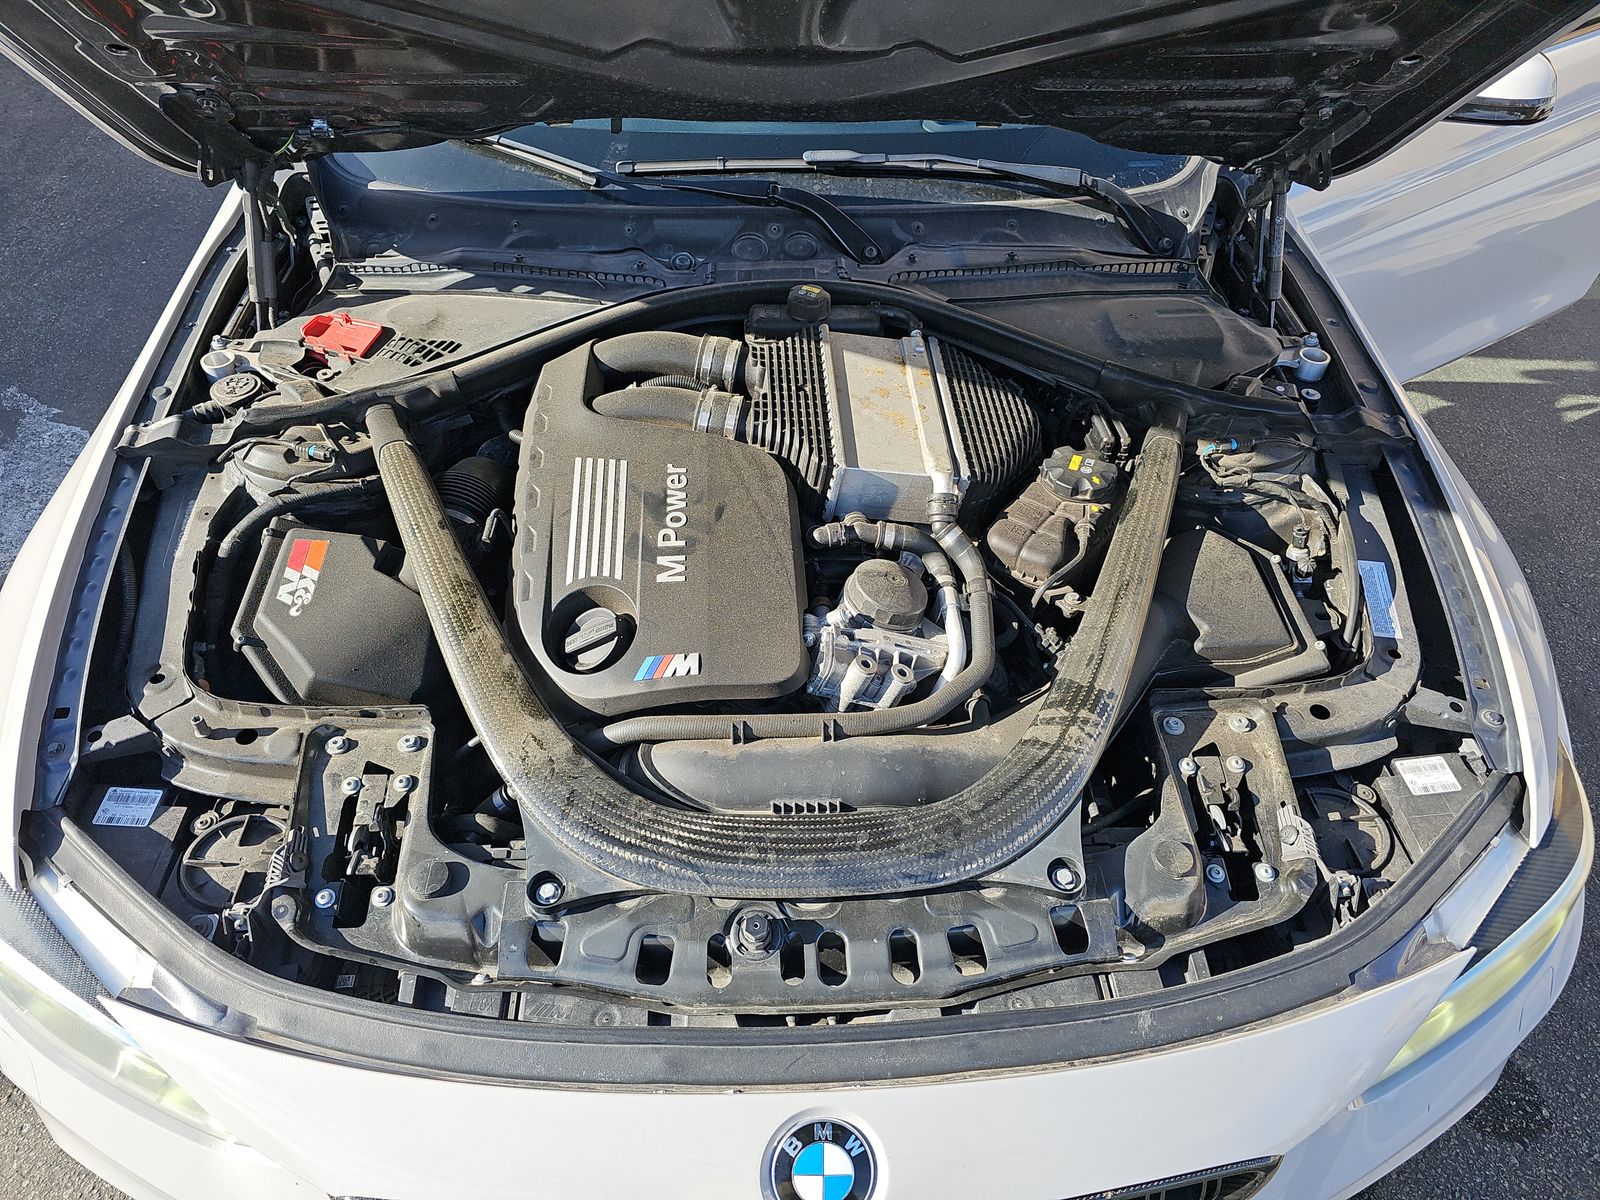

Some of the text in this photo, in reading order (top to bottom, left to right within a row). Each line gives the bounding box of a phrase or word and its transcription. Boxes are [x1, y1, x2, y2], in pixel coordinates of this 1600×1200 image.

[656, 463, 688, 582] M Power
[782, 1122, 865, 1158] BMW
